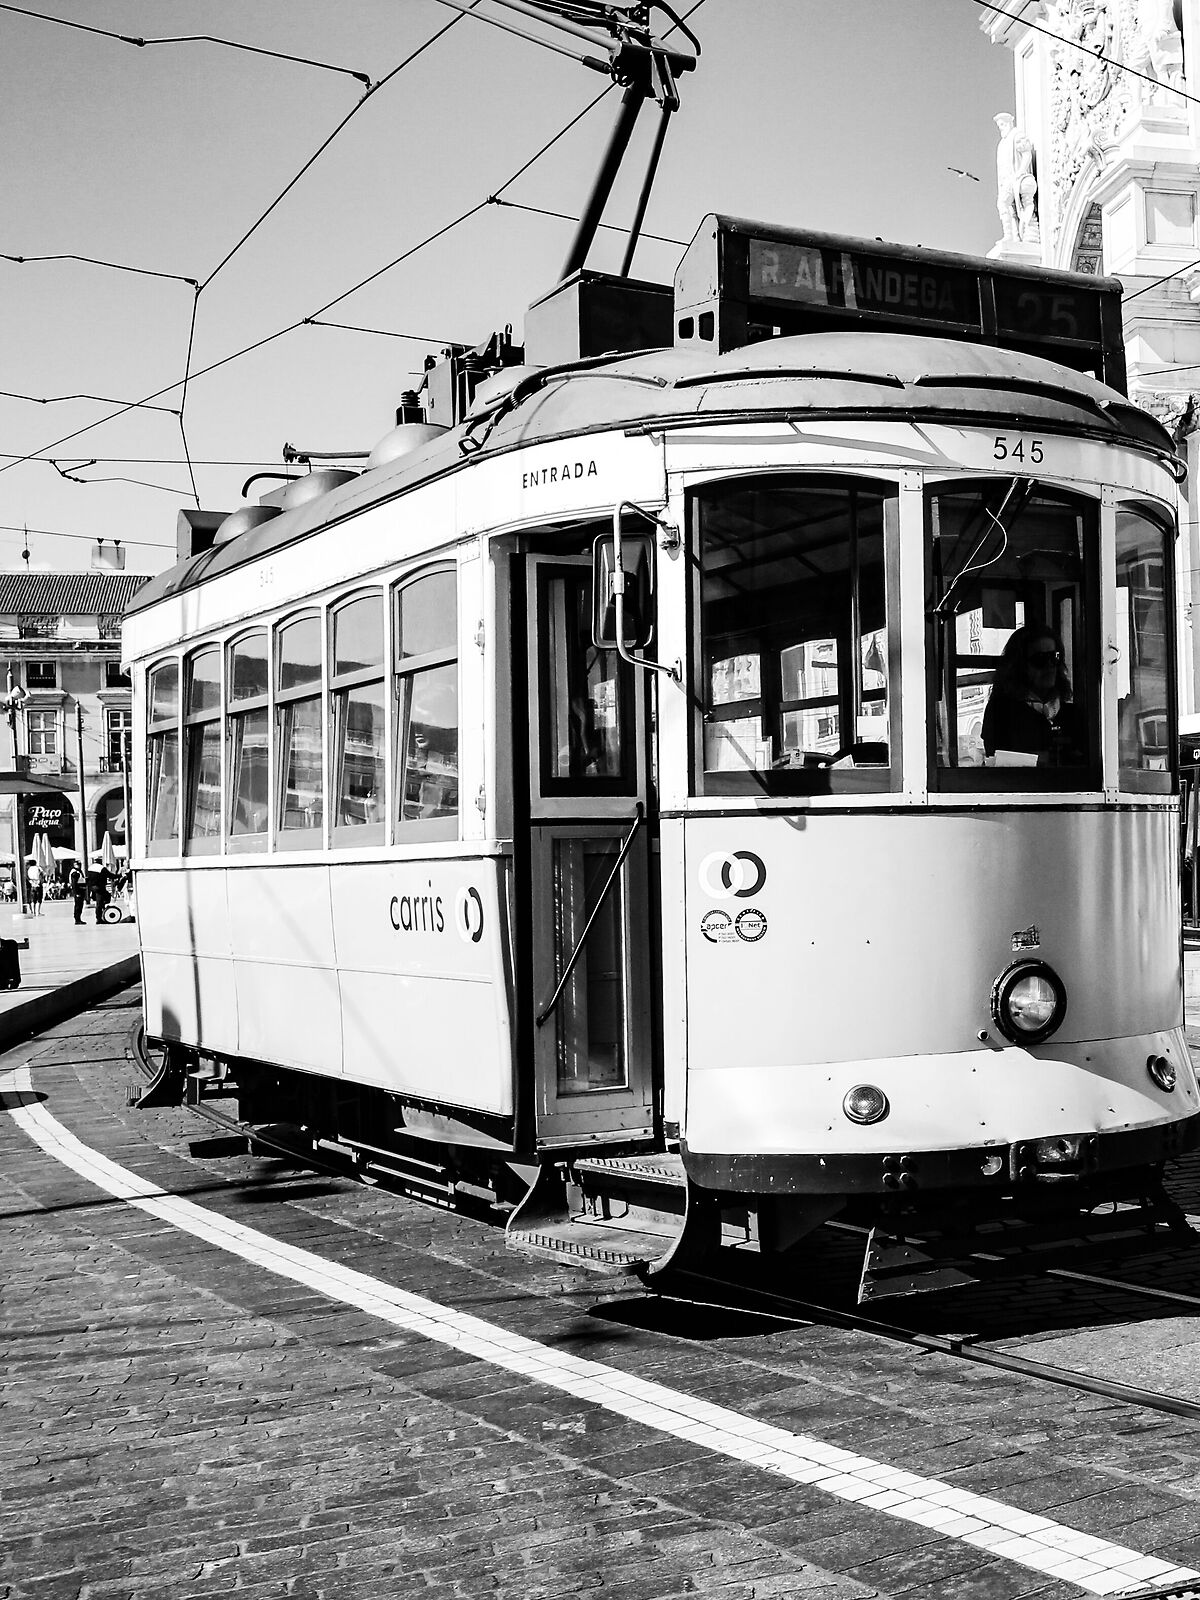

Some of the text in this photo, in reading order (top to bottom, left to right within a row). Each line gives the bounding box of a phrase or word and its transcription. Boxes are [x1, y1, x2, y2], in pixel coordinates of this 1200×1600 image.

[761, 250, 955, 311] R. ALFANDEGA
[1016, 291, 1079, 338] 25
[993, 436, 1044, 463] 545
[522, 460, 598, 489] ENTRADA
[28, 806, 62, 819] Paço
[389, 879, 445, 932] carris
